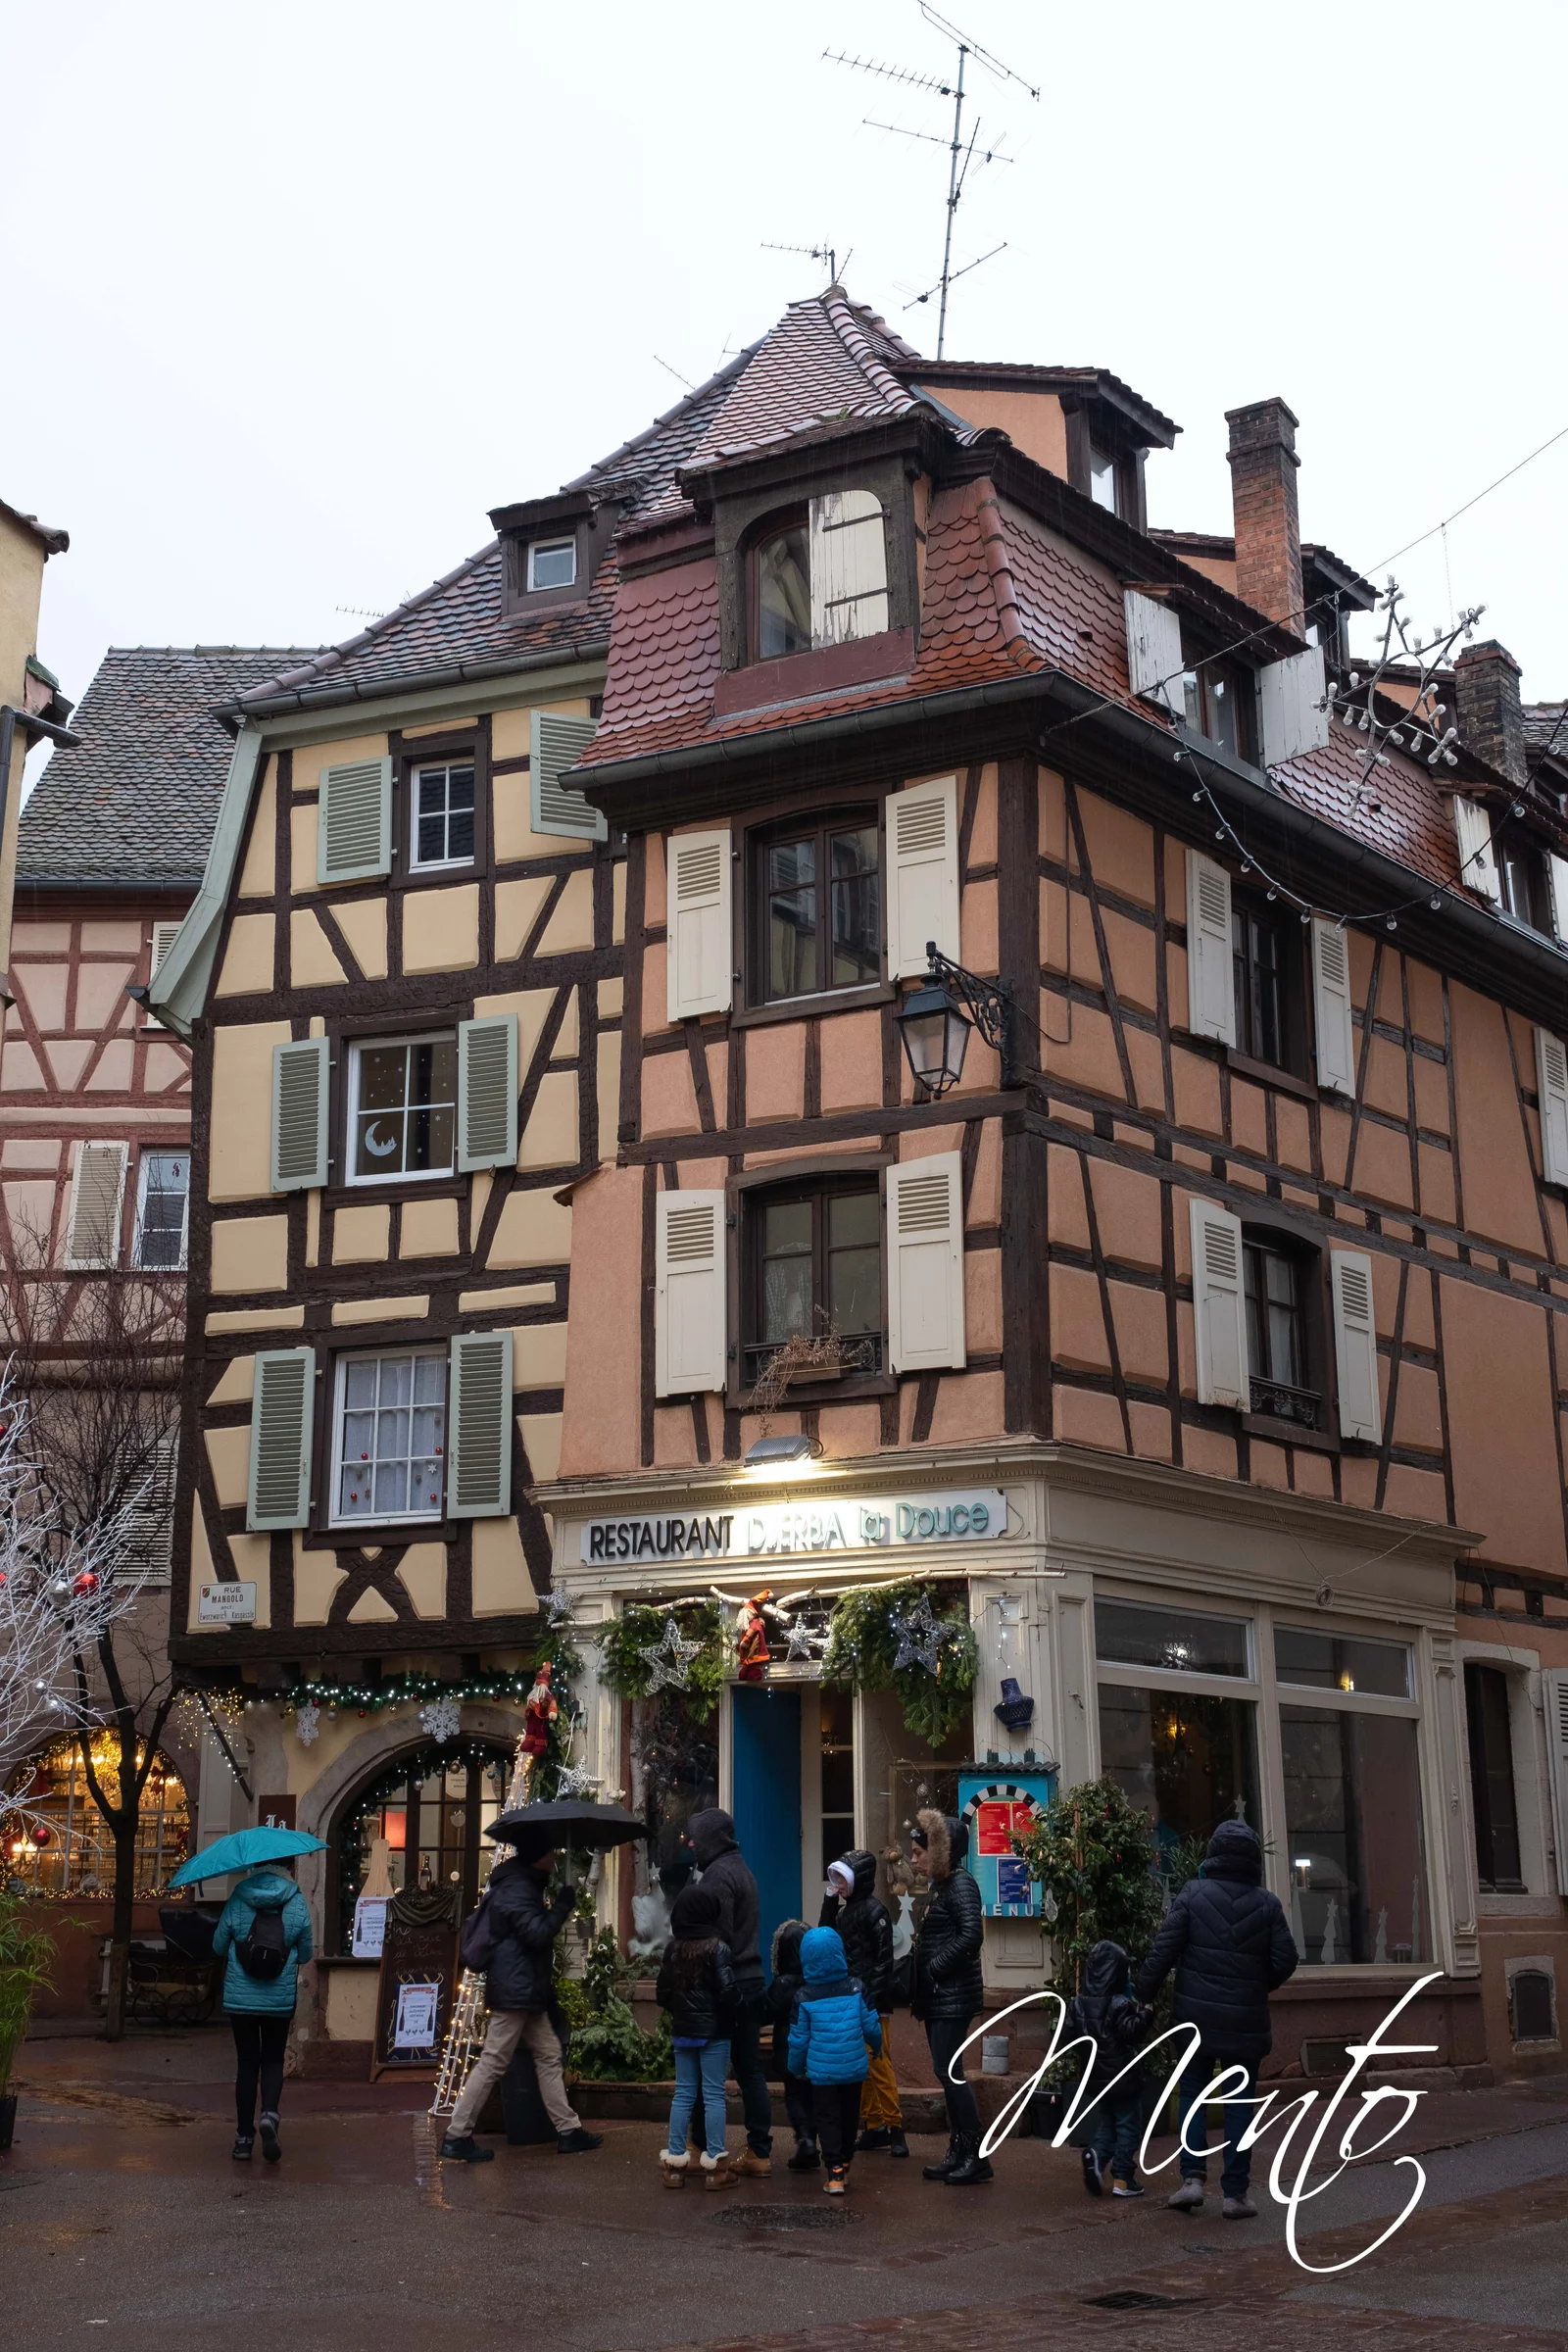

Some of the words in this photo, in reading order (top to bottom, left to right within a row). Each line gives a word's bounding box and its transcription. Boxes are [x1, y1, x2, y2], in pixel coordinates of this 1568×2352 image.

[590, 1515, 734, 1558] RESTAURANT
[748, 1509, 848, 1552] DJERBA
[858, 1505, 881, 1540] la
[896, 1501, 989, 1538] Douce
[211, 1593, 244, 1604] MANGOLD
